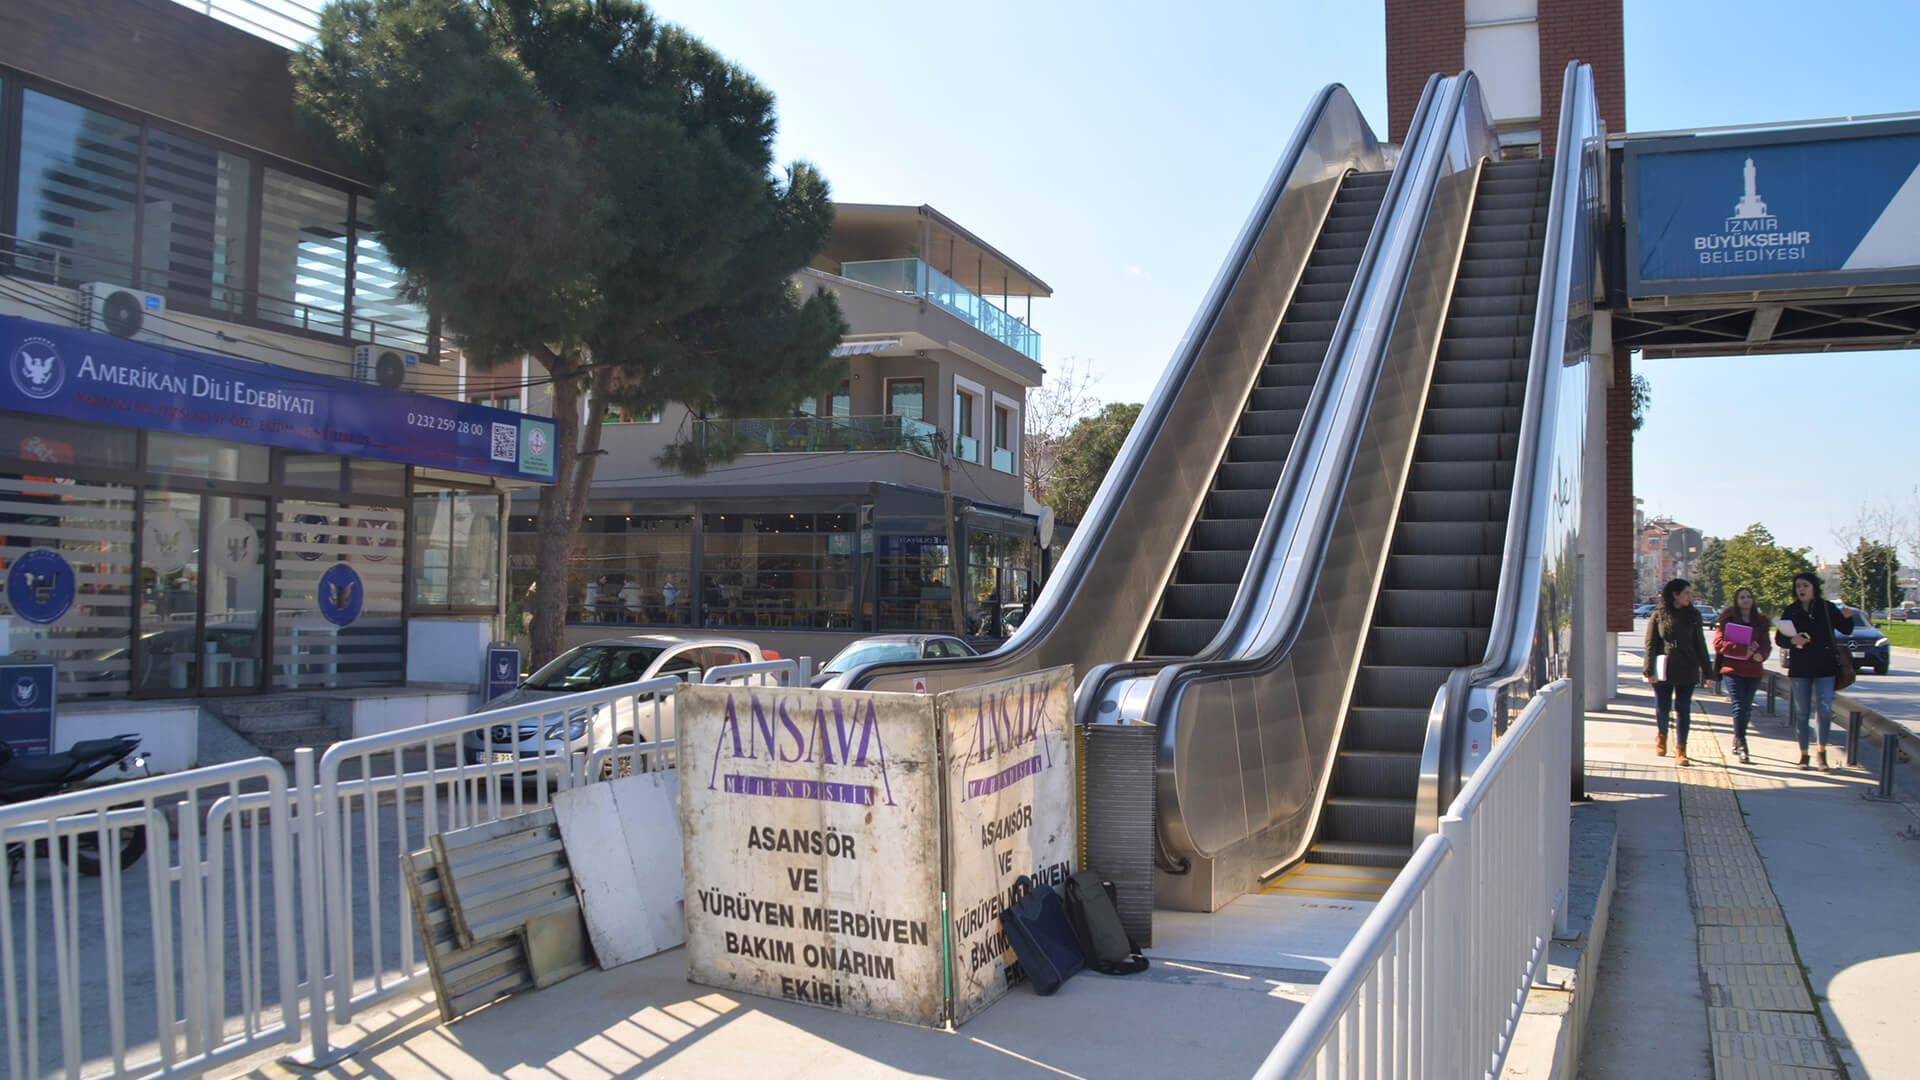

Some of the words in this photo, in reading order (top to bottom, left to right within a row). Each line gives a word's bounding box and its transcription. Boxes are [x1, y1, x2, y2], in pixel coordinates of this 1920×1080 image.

[1694, 230, 1811, 250] BÜYÜKŞEHİR
[1725, 218, 1778, 233] İZMİR
[1700, 246, 1806, 264] BELEDİYESİ
[77, 355, 188, 395] AMERİKAN
[192, 373, 230, 402] DİLİ
[234, 381, 315, 416] EDEBİYATI
[407, 412, 416, 425] 0
[416, 414, 436, 429] 232
[437, 417, 456, 432] 259
[457, 420, 470, 434] 28
[471, 423, 484, 436] 00
[707, 693, 898, 807] ANSAVA
[747, 825, 856, 860] ASANSÖR
[981, 803, 1033, 850] ASANSÖR
[788, 867, 819, 893] VE
[998, 850, 1013, 877] VE
[698, 886, 795, 929] YÜRÜYEN
[803, 907, 929, 947] MERDİVEN
[725, 931, 796, 965] BAKIM
[803, 944, 896, 981] ONARIM
[781, 974, 843, 1009] EKİBİ
